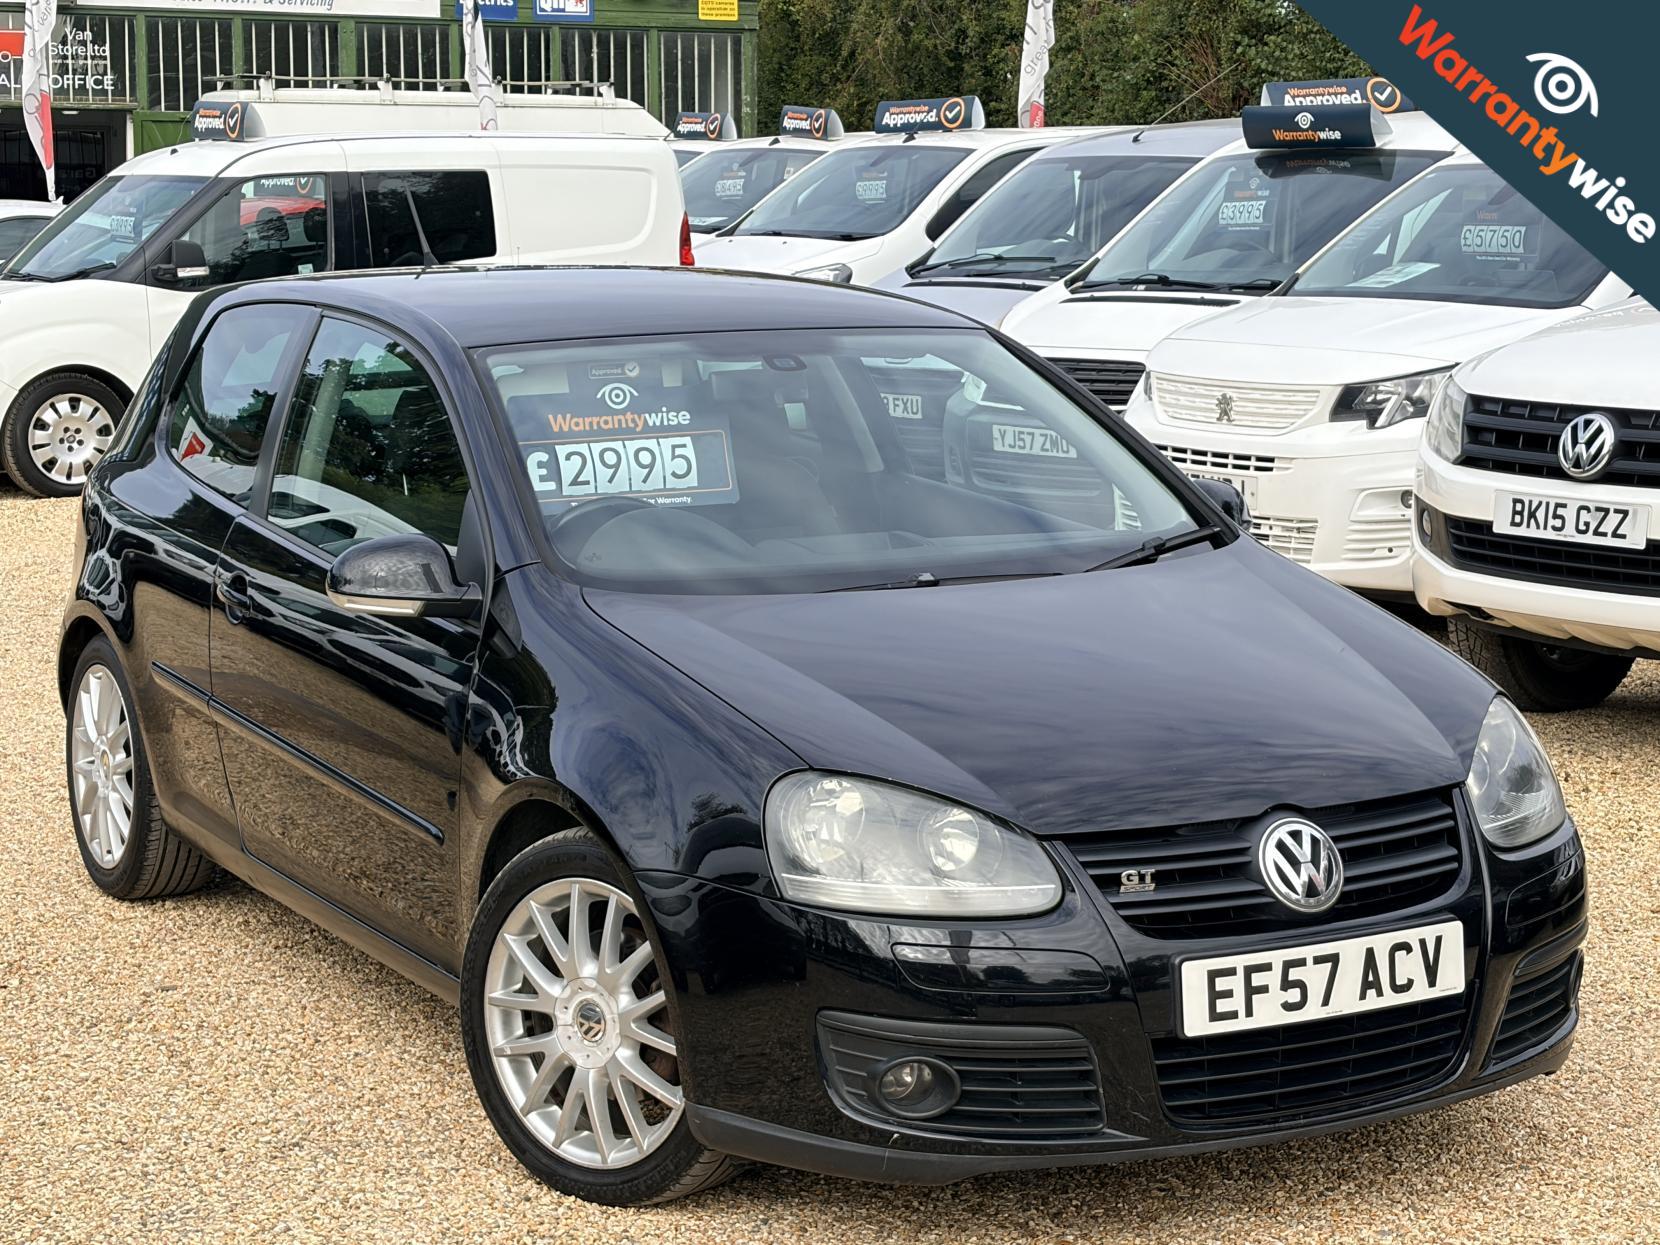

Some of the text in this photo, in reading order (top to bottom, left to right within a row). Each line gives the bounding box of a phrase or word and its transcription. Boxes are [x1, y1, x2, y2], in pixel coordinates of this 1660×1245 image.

[65, 28, 92, 40] Van
[49, 75, 114, 89] OFFICE
[1287, 85, 1347, 96] Warrantywise
[1272, 128, 1342, 142] Warrantywise
[1220, 202, 1263, 221] £3995
[1463, 229, 1522, 249] £5750
[893, 396, 919, 416] FXU
[548, 407, 690, 432] Warrantywise
[998, 428, 1035, 451] YJ57
[527, 444, 692, 491] £2995
[1510, 498, 1629, 540] BK15 GZZ
[1121, 869, 1156, 885] GT
[1207, 935, 1443, 1022] EF57 ACV
